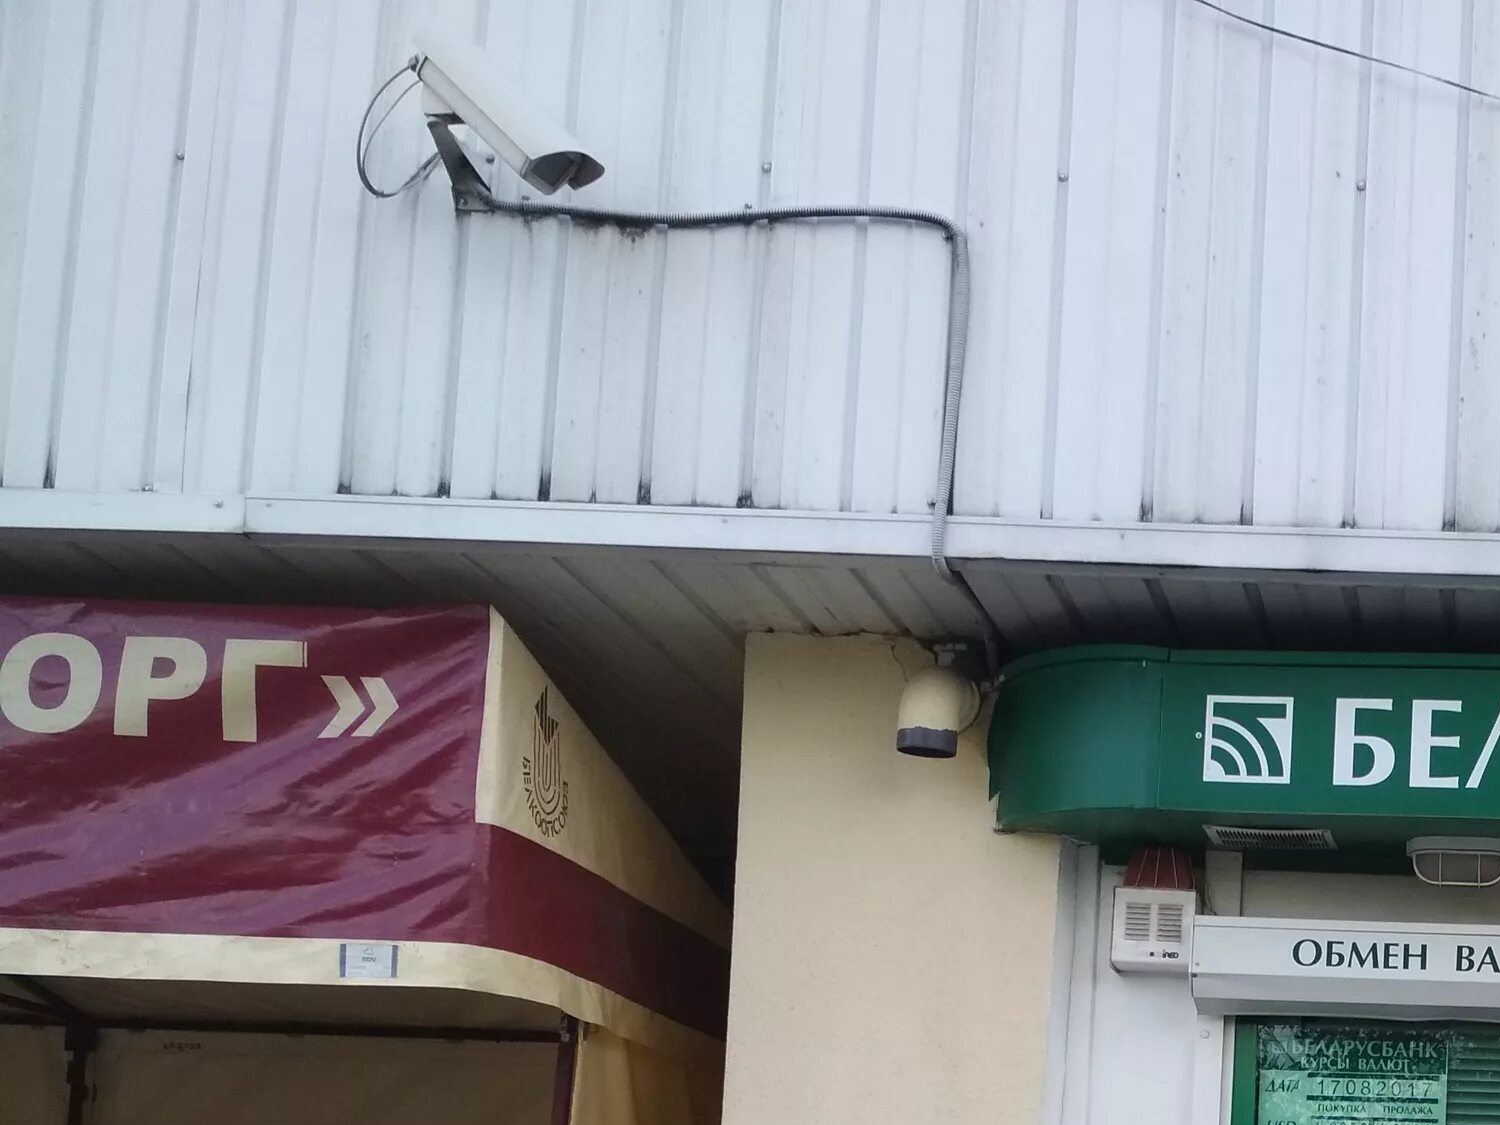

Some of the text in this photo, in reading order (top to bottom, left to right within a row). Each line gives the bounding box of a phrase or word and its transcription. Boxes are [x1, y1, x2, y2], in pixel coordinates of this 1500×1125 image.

[1292, 939, 1428, 970] ОБМЕН
[1294, 1038, 1438, 1058] БЕЛАРУСБАНК
[1300, 1055, 1410, 1072] КУРСЫ ВАЛЮТ
[1265, 1079, 1300, 1093] ДАТА
[1317, 1103, 1433, 1116] ПОКУПКА ПРОДАЖА
